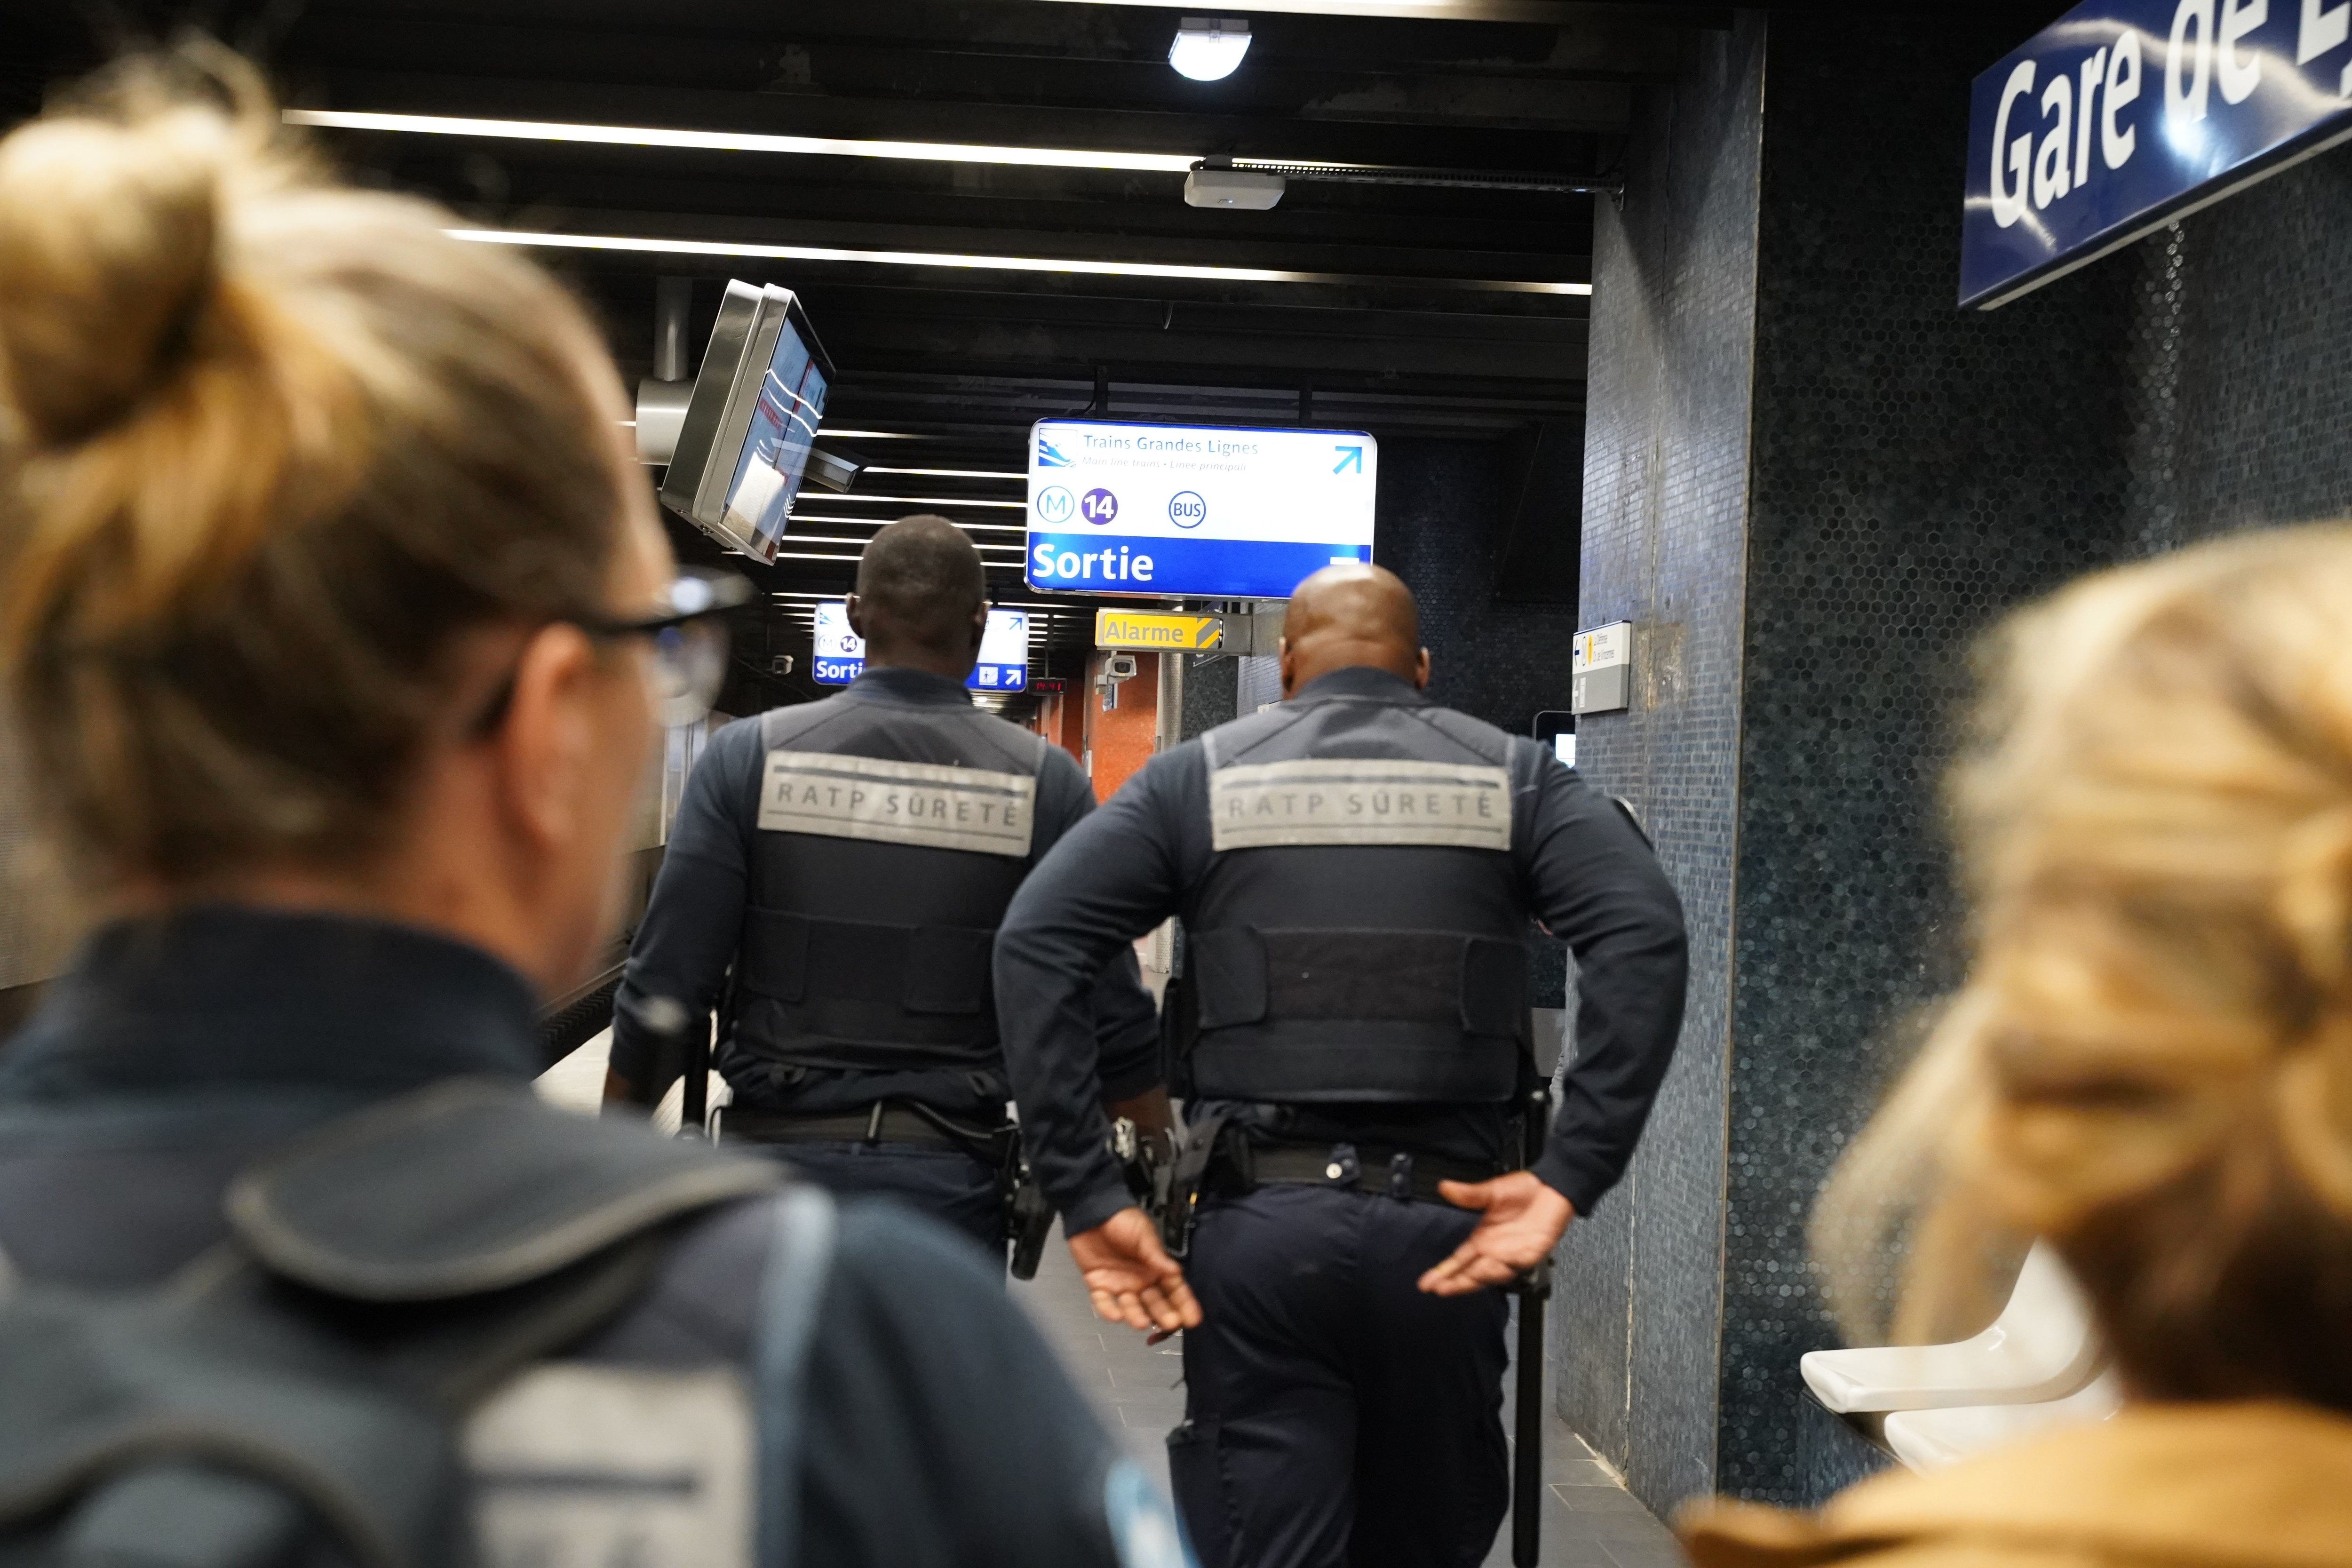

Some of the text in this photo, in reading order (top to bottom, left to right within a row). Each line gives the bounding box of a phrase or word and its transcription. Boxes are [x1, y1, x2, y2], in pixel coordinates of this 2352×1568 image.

[1990, 30, 2141, 228] Gare
[1083, 435, 1258, 456] Trains Grandes Lignes
[1082, 457, 1107, 465] Main
[1111, 458, 1129, 467] line
[1170, 461, 1196, 470] Linee
[1200, 462, 1247, 473] principali
[1047, 494, 1201, 519] M 14 BUS
[1033, 543, 1154, 581] Sortie
[823, 637, 856, 650] M 14
[1105, 621, 1184, 643] Alarme
[816, 661, 863, 678] Sorti
[777, 782, 1017, 827] RATP SÛRETÉ
[1229, 789, 1493, 818] RATP SÛRETÉ
